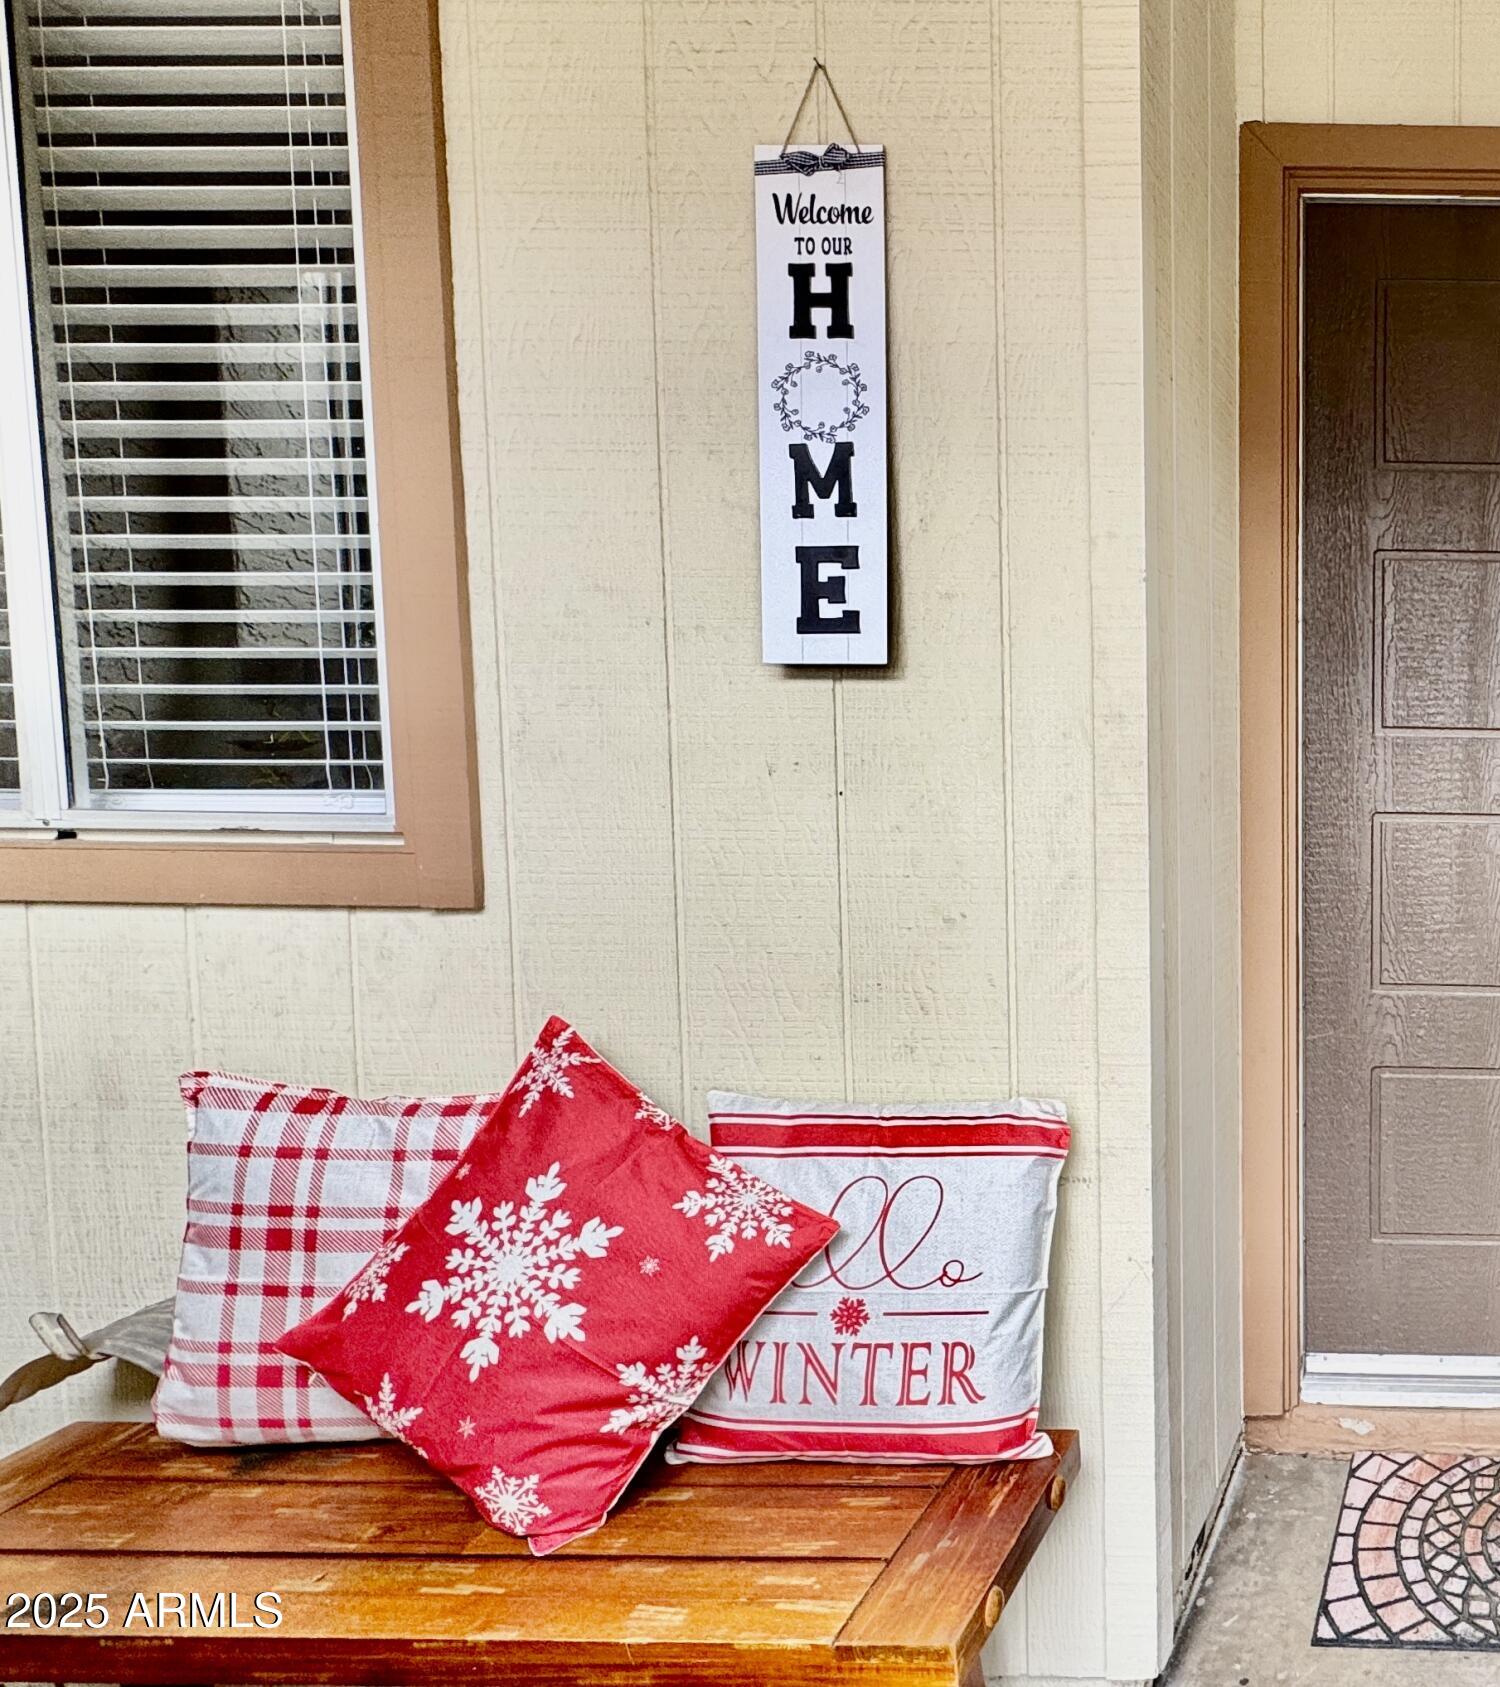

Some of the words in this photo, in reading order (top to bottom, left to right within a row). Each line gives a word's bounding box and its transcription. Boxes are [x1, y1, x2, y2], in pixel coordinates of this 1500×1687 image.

[771, 192, 874, 225] Welcome
[794, 236, 816, 255] TO
[821, 236, 853, 255] OUR
[723, 1340, 986, 1406] WINTER
